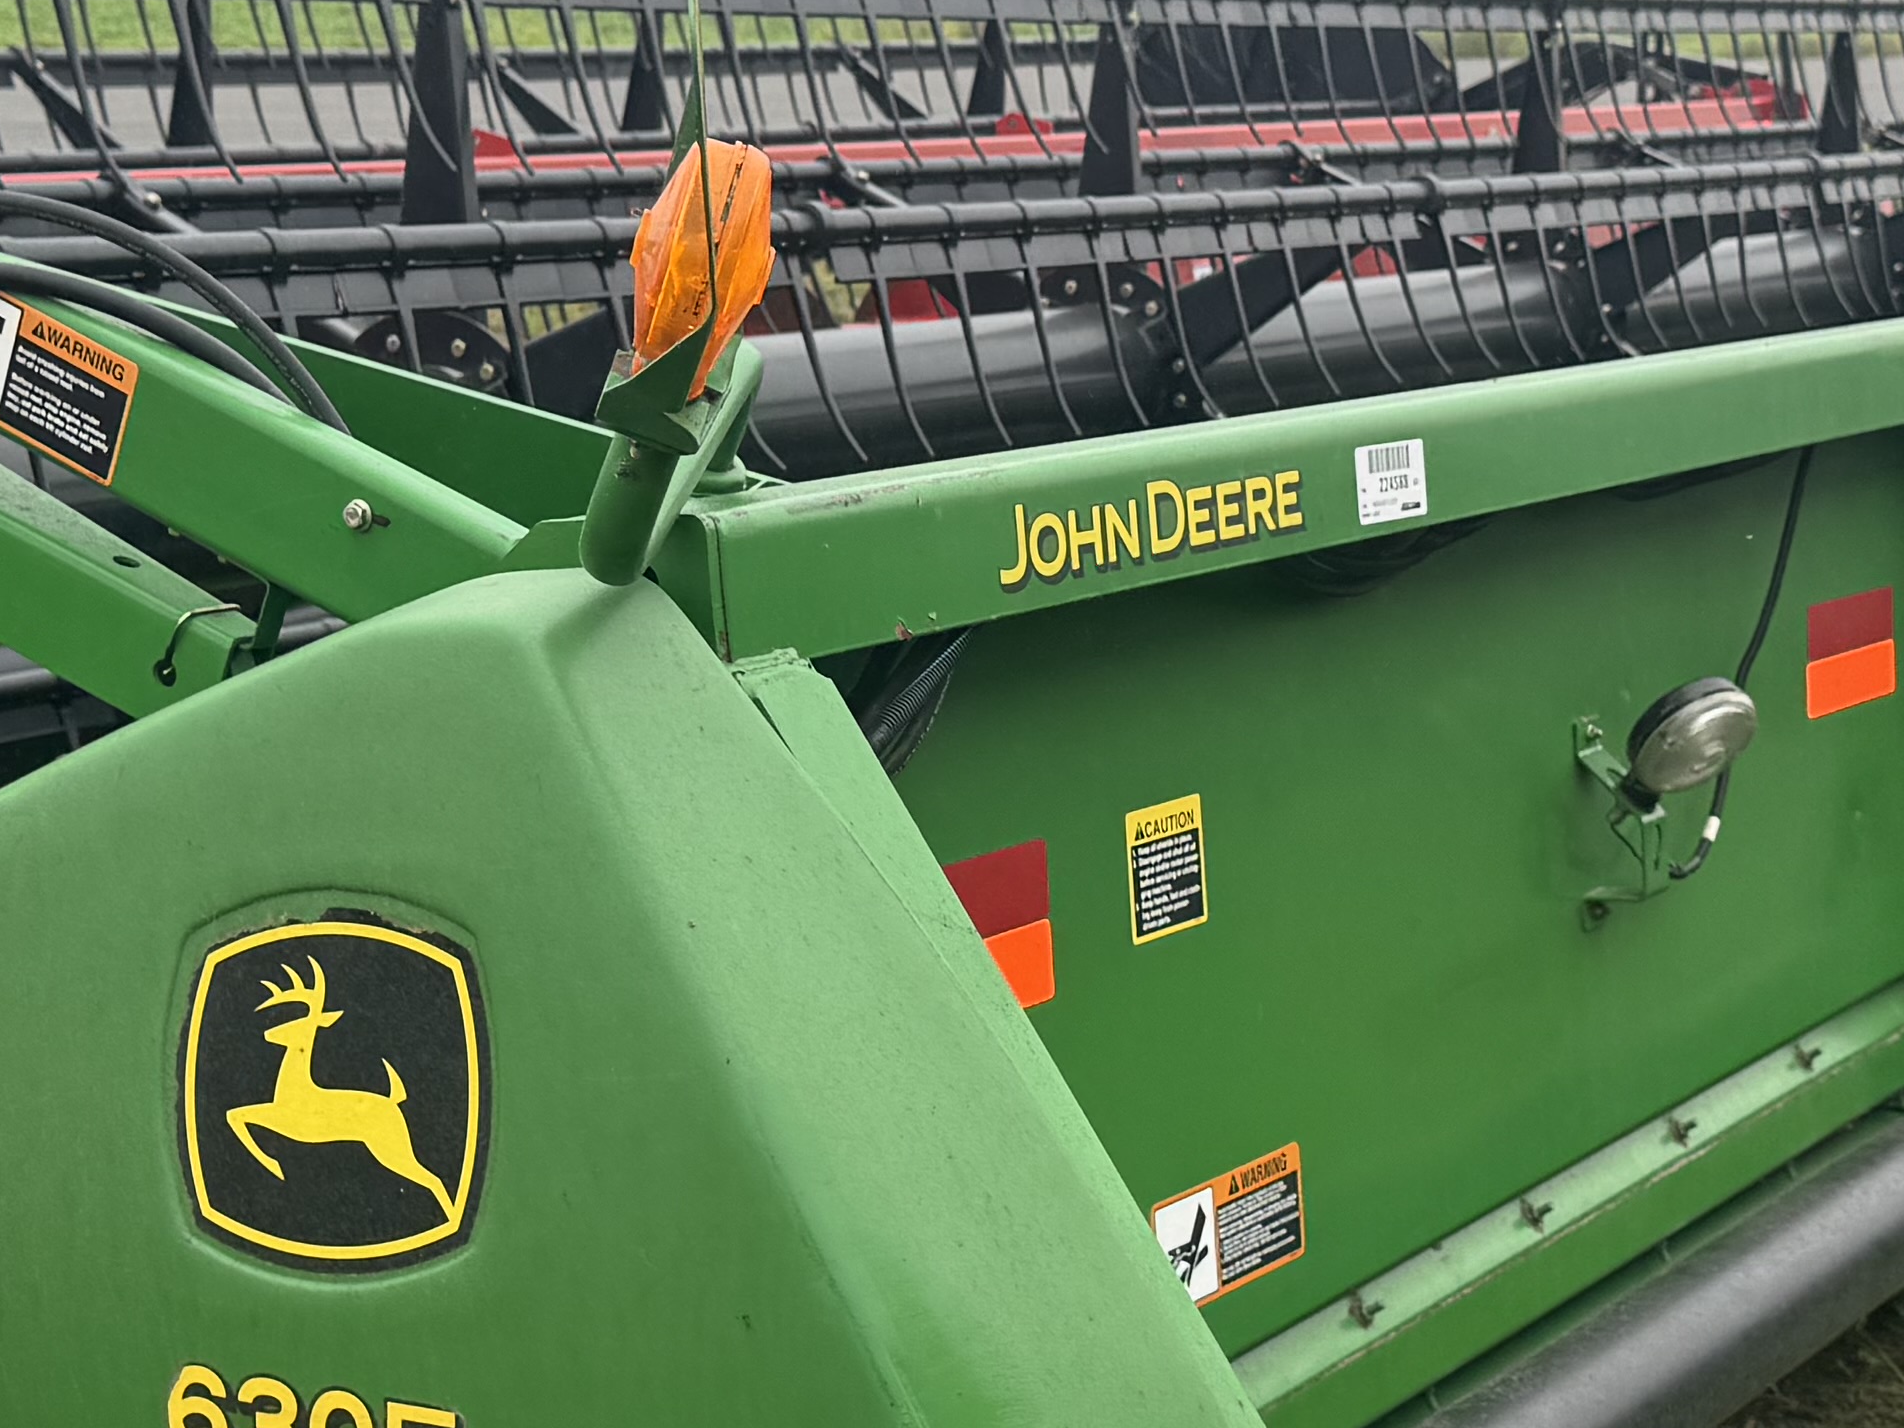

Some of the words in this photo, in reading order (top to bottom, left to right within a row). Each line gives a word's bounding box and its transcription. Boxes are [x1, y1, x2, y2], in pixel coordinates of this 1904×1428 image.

[48, 325, 126, 382] WARNING
[999, 498, 1141, 586] JOHN
[1147, 469, 1303, 556] DEERE
[1145, 809, 1194, 838] CAUTION
[1241, 1152, 1287, 1189] WARNING
